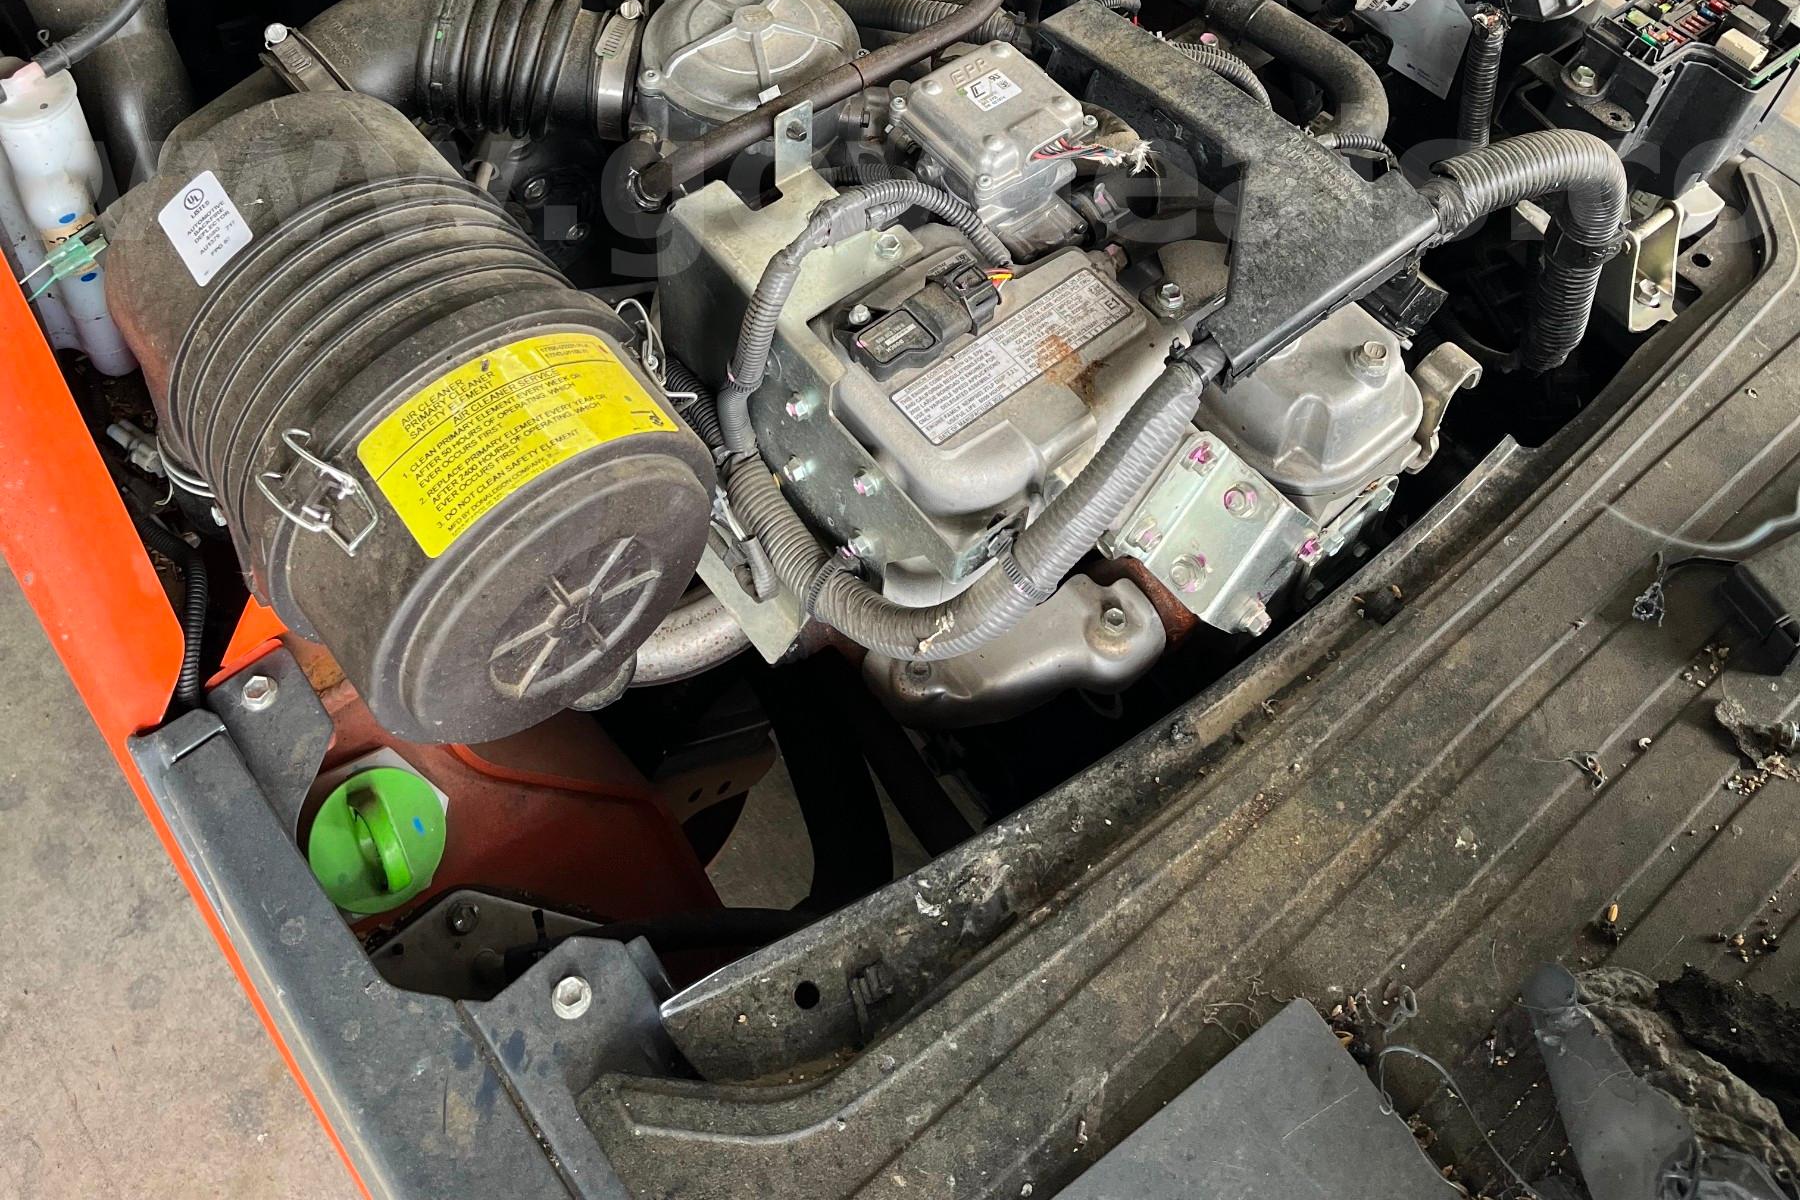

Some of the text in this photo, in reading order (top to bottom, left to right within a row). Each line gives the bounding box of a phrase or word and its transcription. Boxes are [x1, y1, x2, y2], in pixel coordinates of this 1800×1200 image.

[187, 194, 200, 205] UL
[187, 200, 224, 236] AUTOMOTIVE
[191, 200, 210, 219] LISTED
[194, 208, 224, 237] BACKFIRE
[194, 210, 230, 244] DEFLECTOR
[1103, 296, 1121, 310] E1
[400, 379, 463, 425] AIR CLEANER
[404, 370, 495, 431] PRIMARY CLEANER
[409, 380, 493, 439] SAFETY ELEMENT
[409, 446, 437, 473] CLEAN
[436, 418, 476, 449] PRIMARY
[475, 395, 517, 421] ELEMENT
[516, 383, 546, 399] EVERY
[544, 375, 571, 387] WEEK
[451, 367, 559, 424] AIR CLEANER SERVICE
[413, 455, 441, 480] AFTER
[440, 446, 452, 457] 50
[451, 424, 483, 449] HOURS
[483, 416, 497, 426] OF
[547, 381, 576, 395] WHICH
[418, 423, 503, 488] EVER OCCURS FIRST
[426, 463, 464, 497] REPLACE
[464, 435, 504, 465] PRIMARY
[503, 413, 544, 438] ELEMENT
[543, 402, 575, 417] EVERY
[572, 395, 595, 406] YEAR
[431, 478, 460, 504] AFTER
[458, 463, 478, 480] 2400
[477, 442, 509, 465] HOURS
[508, 434, 523, 445] OF
[573, 400, 602, 414] WHICH
[435, 444, 520, 512] EVER OCCURS FIRST
[444, 507, 459, 521] DO
[457, 491, 476, 510] NOT
[475, 469, 505, 494] CLEAN
[504, 448, 539, 472] SAFETY
[539, 428, 580, 451] ELEMENT
[447, 517, 463, 532] MFD
[461, 509, 471, 520] BY
[470, 477, 513, 510] DONALDSON
